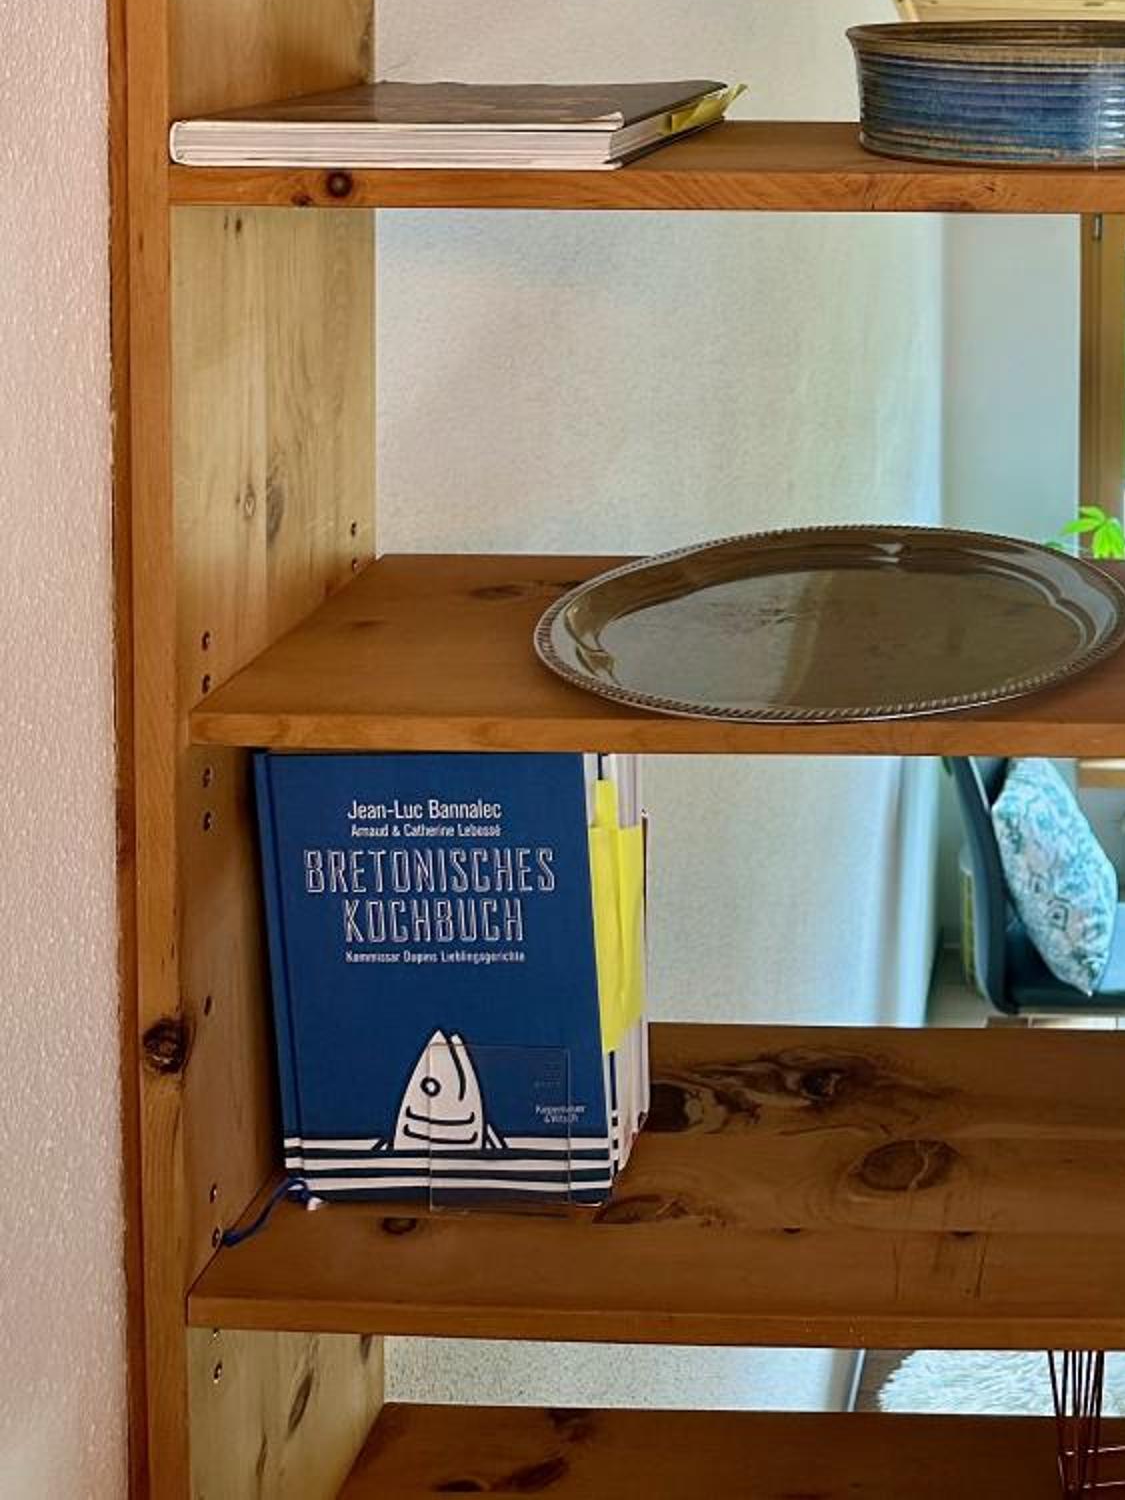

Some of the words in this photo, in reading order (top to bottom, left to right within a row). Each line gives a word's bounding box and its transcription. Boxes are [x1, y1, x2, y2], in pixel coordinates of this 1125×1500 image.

[347, 798, 424, 820] Jean-Luc
[428, 798, 503, 820] Bannalec
[351, 823, 389, 837] Arnaud
[391, 823, 401, 837] &
[403, 823, 455, 837] Catherine
[303, 847, 557, 893] BRETONISCHES
[343, 897, 524, 943] KOCHBUCH
[345, 950, 400, 963] Kommissar
[441, 950, 526, 965] Lieblingsgerichte
